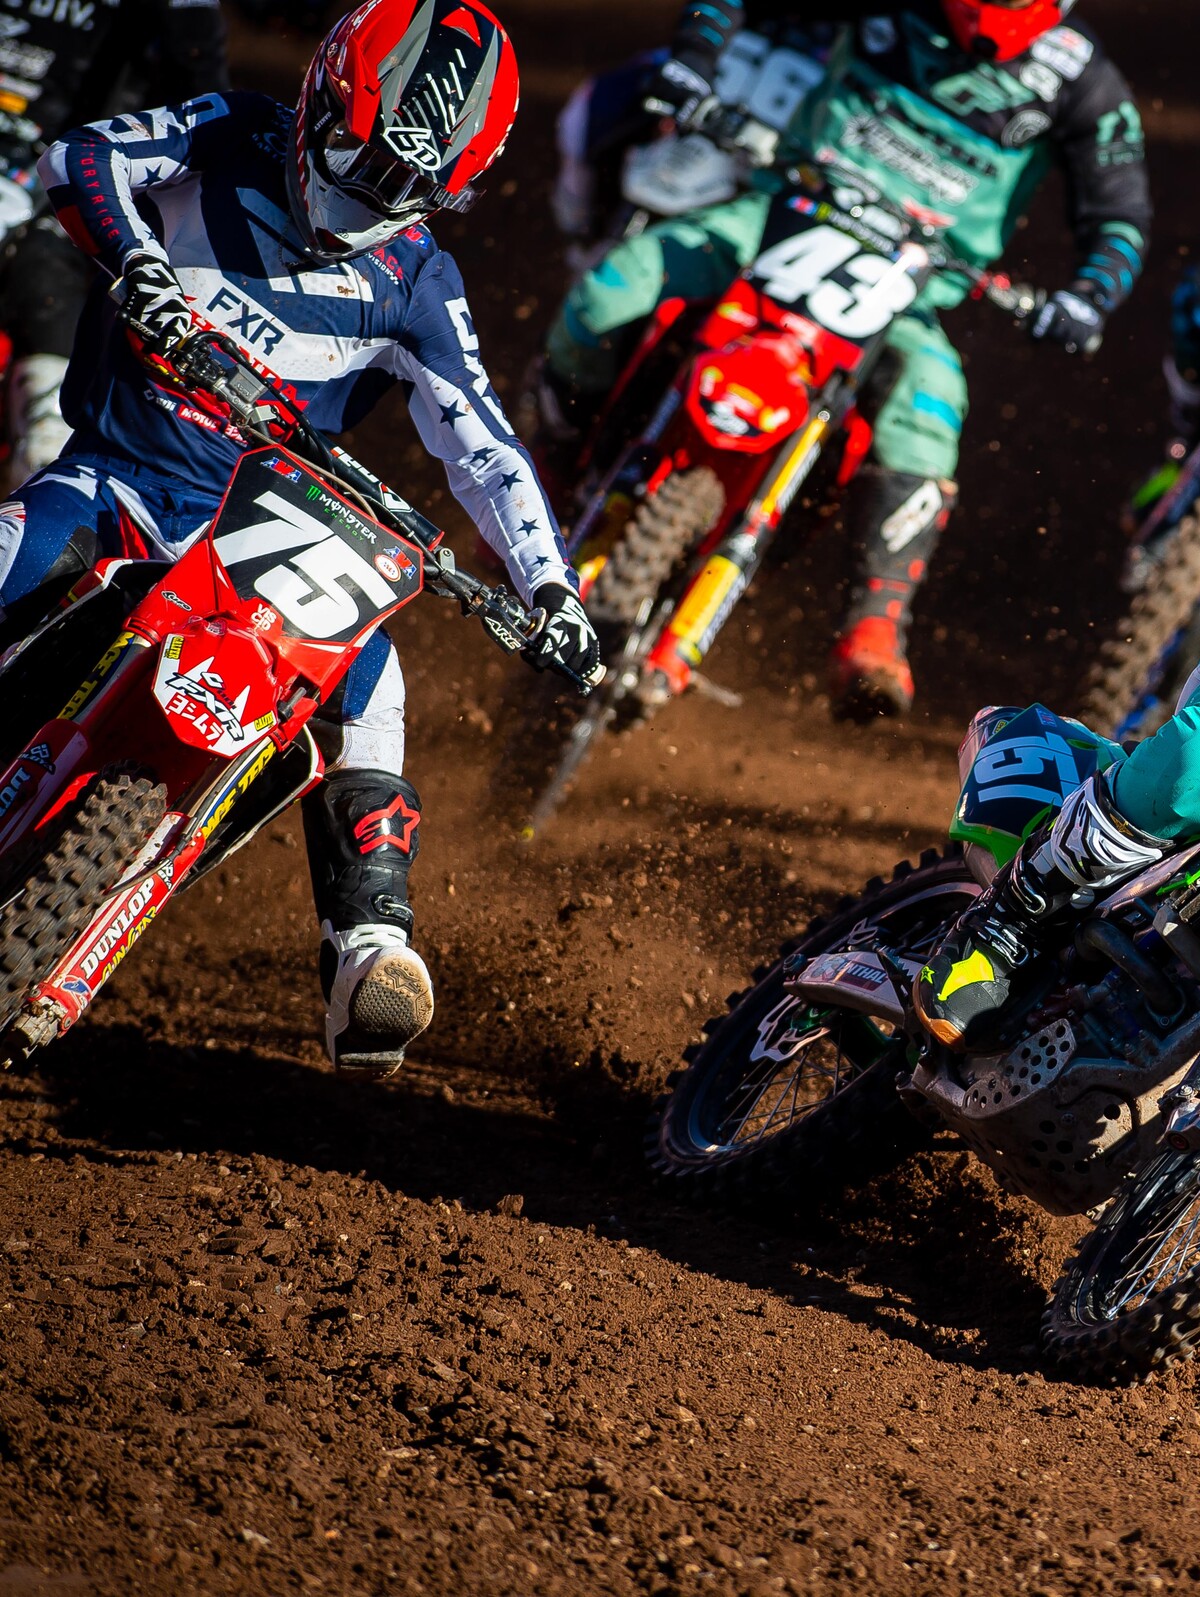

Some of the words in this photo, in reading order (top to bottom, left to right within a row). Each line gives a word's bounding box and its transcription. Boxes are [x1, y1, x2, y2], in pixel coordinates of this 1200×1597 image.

[753, 223, 918, 339] 43
[206, 286, 285, 356] FXR
[180, 407, 217, 430] MOTUL
[319, 493, 378, 544] MONSTER
[323, 507, 365, 542] ENERGY
[213, 490, 398, 639] 75
[257, 604, 277, 621] VIS
[165, 672, 244, 741] FXR
[973, 731, 1081, 807] 157
[79, 877, 155, 980] DUNLOP
[838, 960, 887, 983] NTHAL
